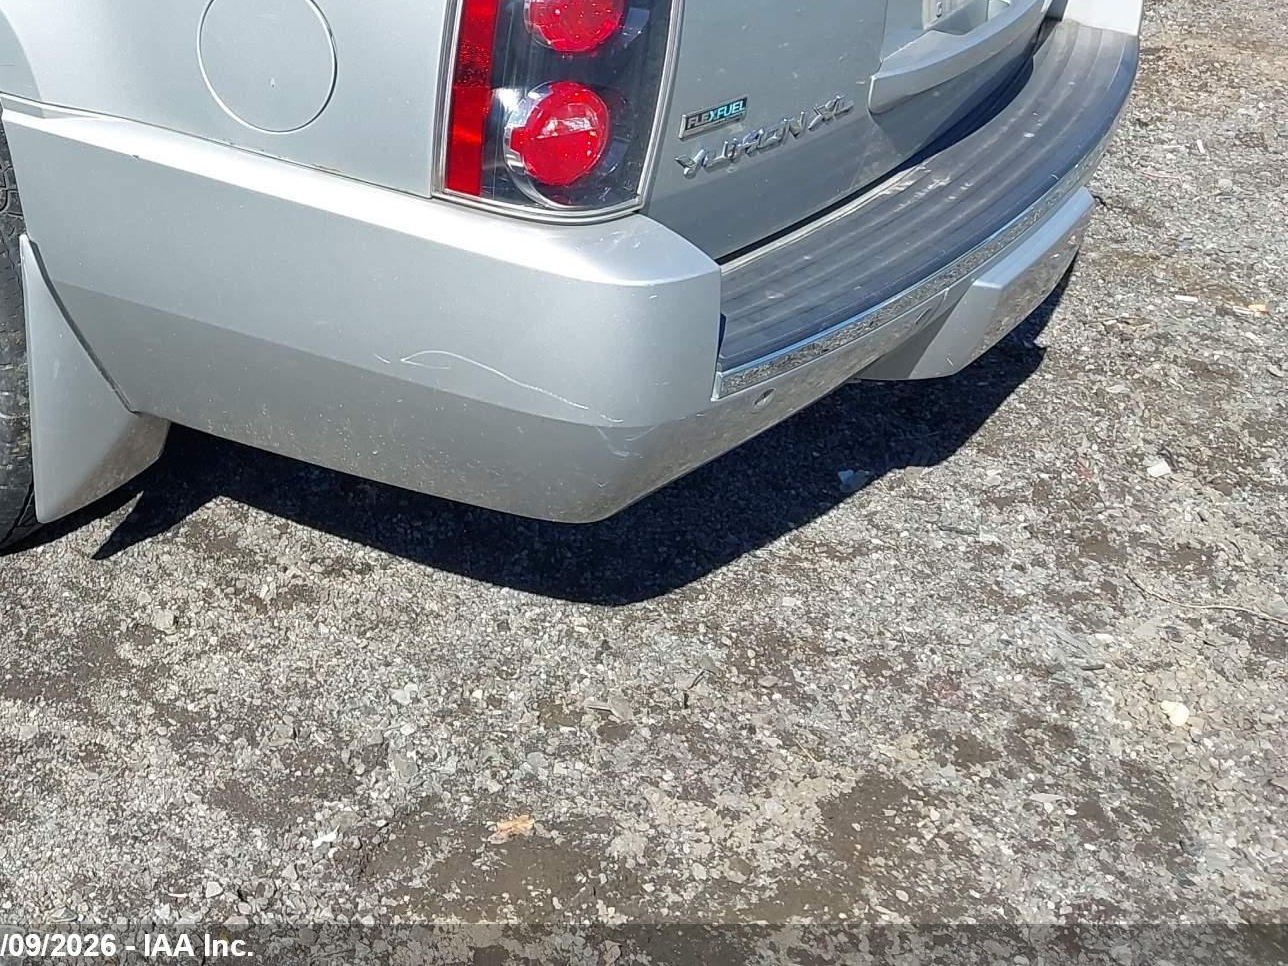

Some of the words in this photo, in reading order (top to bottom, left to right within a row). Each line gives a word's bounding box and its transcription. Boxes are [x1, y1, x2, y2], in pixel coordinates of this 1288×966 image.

[674, 111, 808, 180] YUKON
[807, 94, 855, 132] XL
[686, 99, 747, 130] FLEXFUEL
